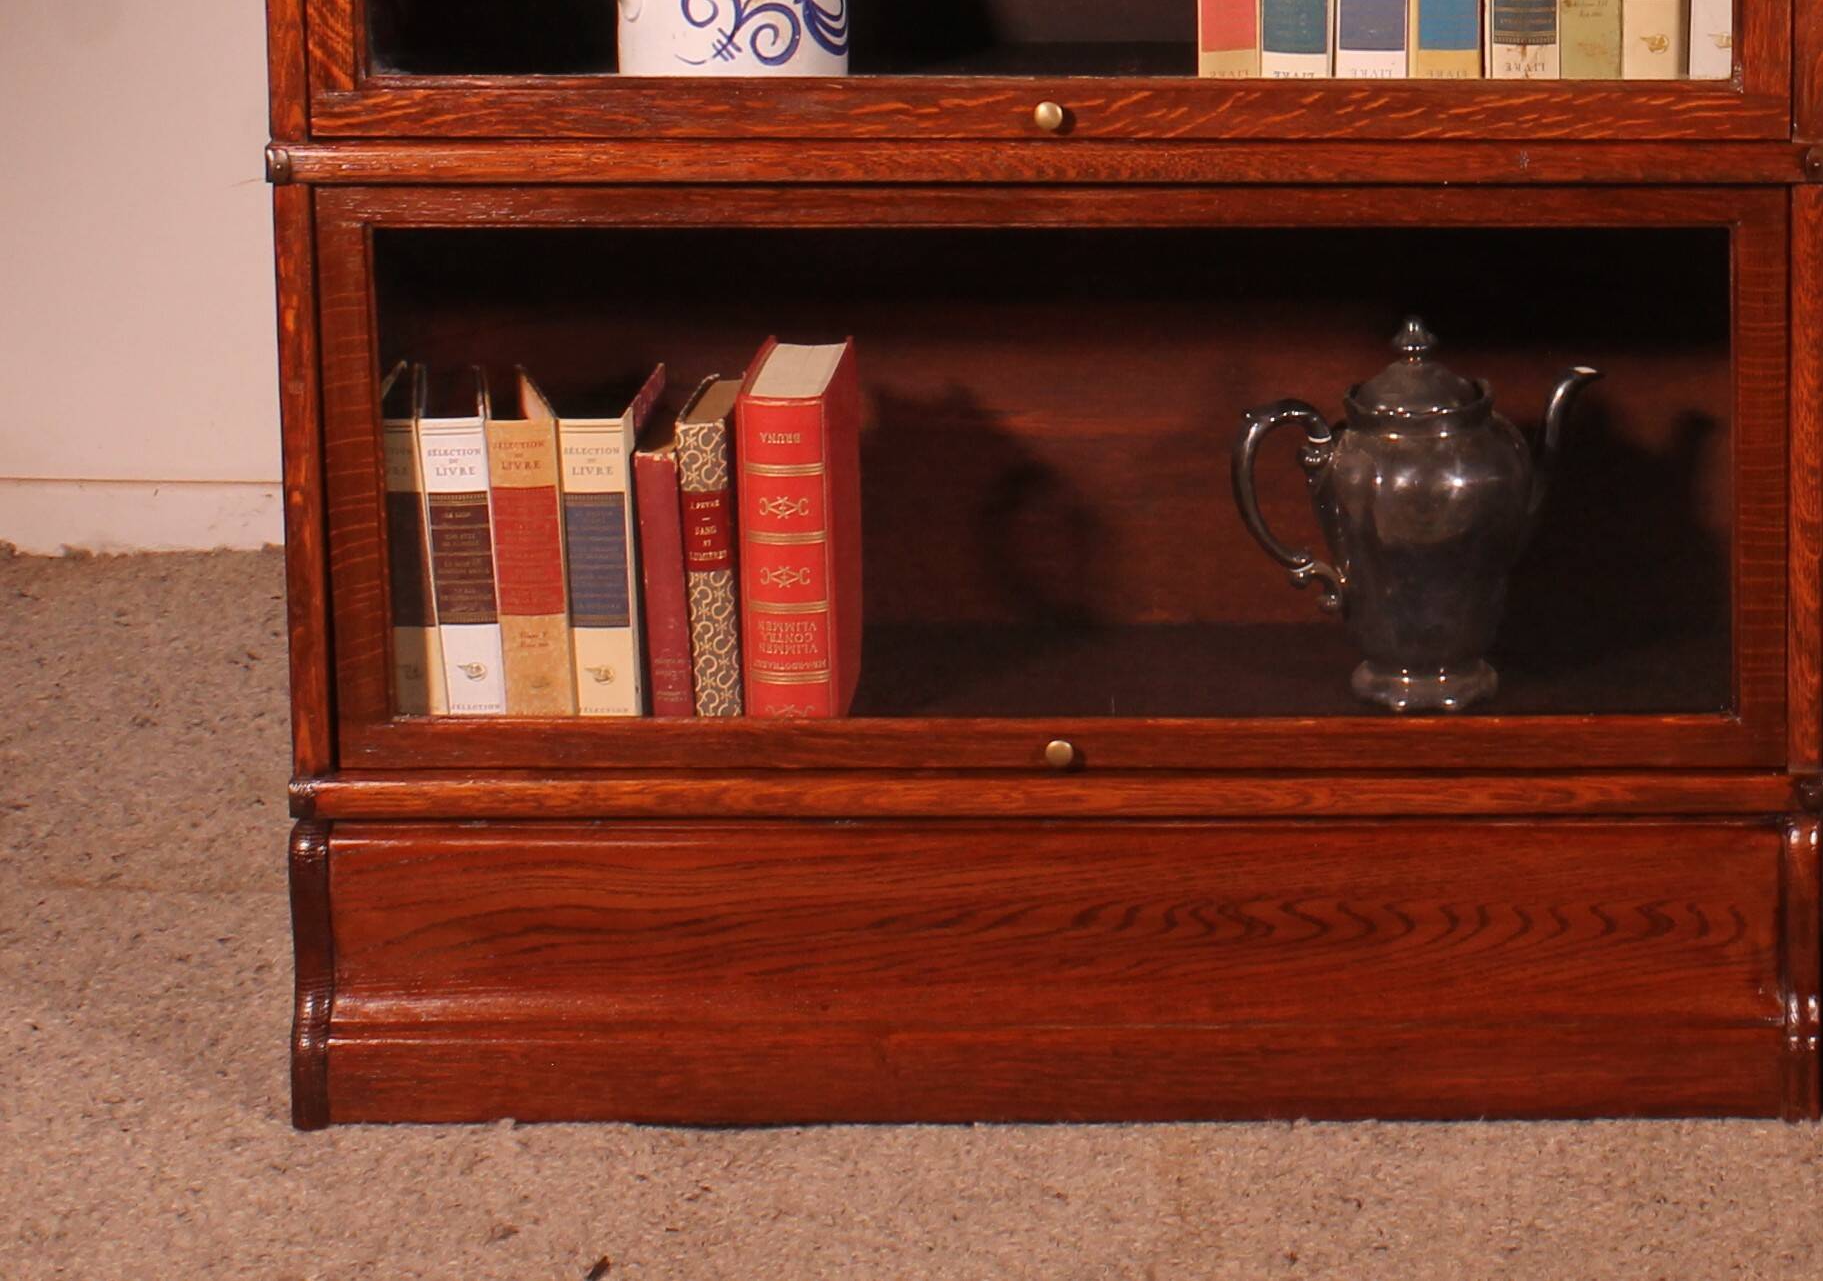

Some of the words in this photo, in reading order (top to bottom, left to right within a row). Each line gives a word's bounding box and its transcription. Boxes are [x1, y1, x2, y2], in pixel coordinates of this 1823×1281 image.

[759, 432, 802, 444] BRUNA
[426, 447, 482, 458] SÉLECTION
[563, 446, 621, 457] SÉLECTION
[500, 460, 542, 471] LIVRE
[435, 466, 476, 477] LIVRE
[571, 466, 614, 477] LIVRE
[694, 526, 718, 536] SANG
[759, 620, 818, 633] VLIMMEN
[763, 632, 814, 644] CONTRA
[759, 644, 819, 656] VLIMMEN
